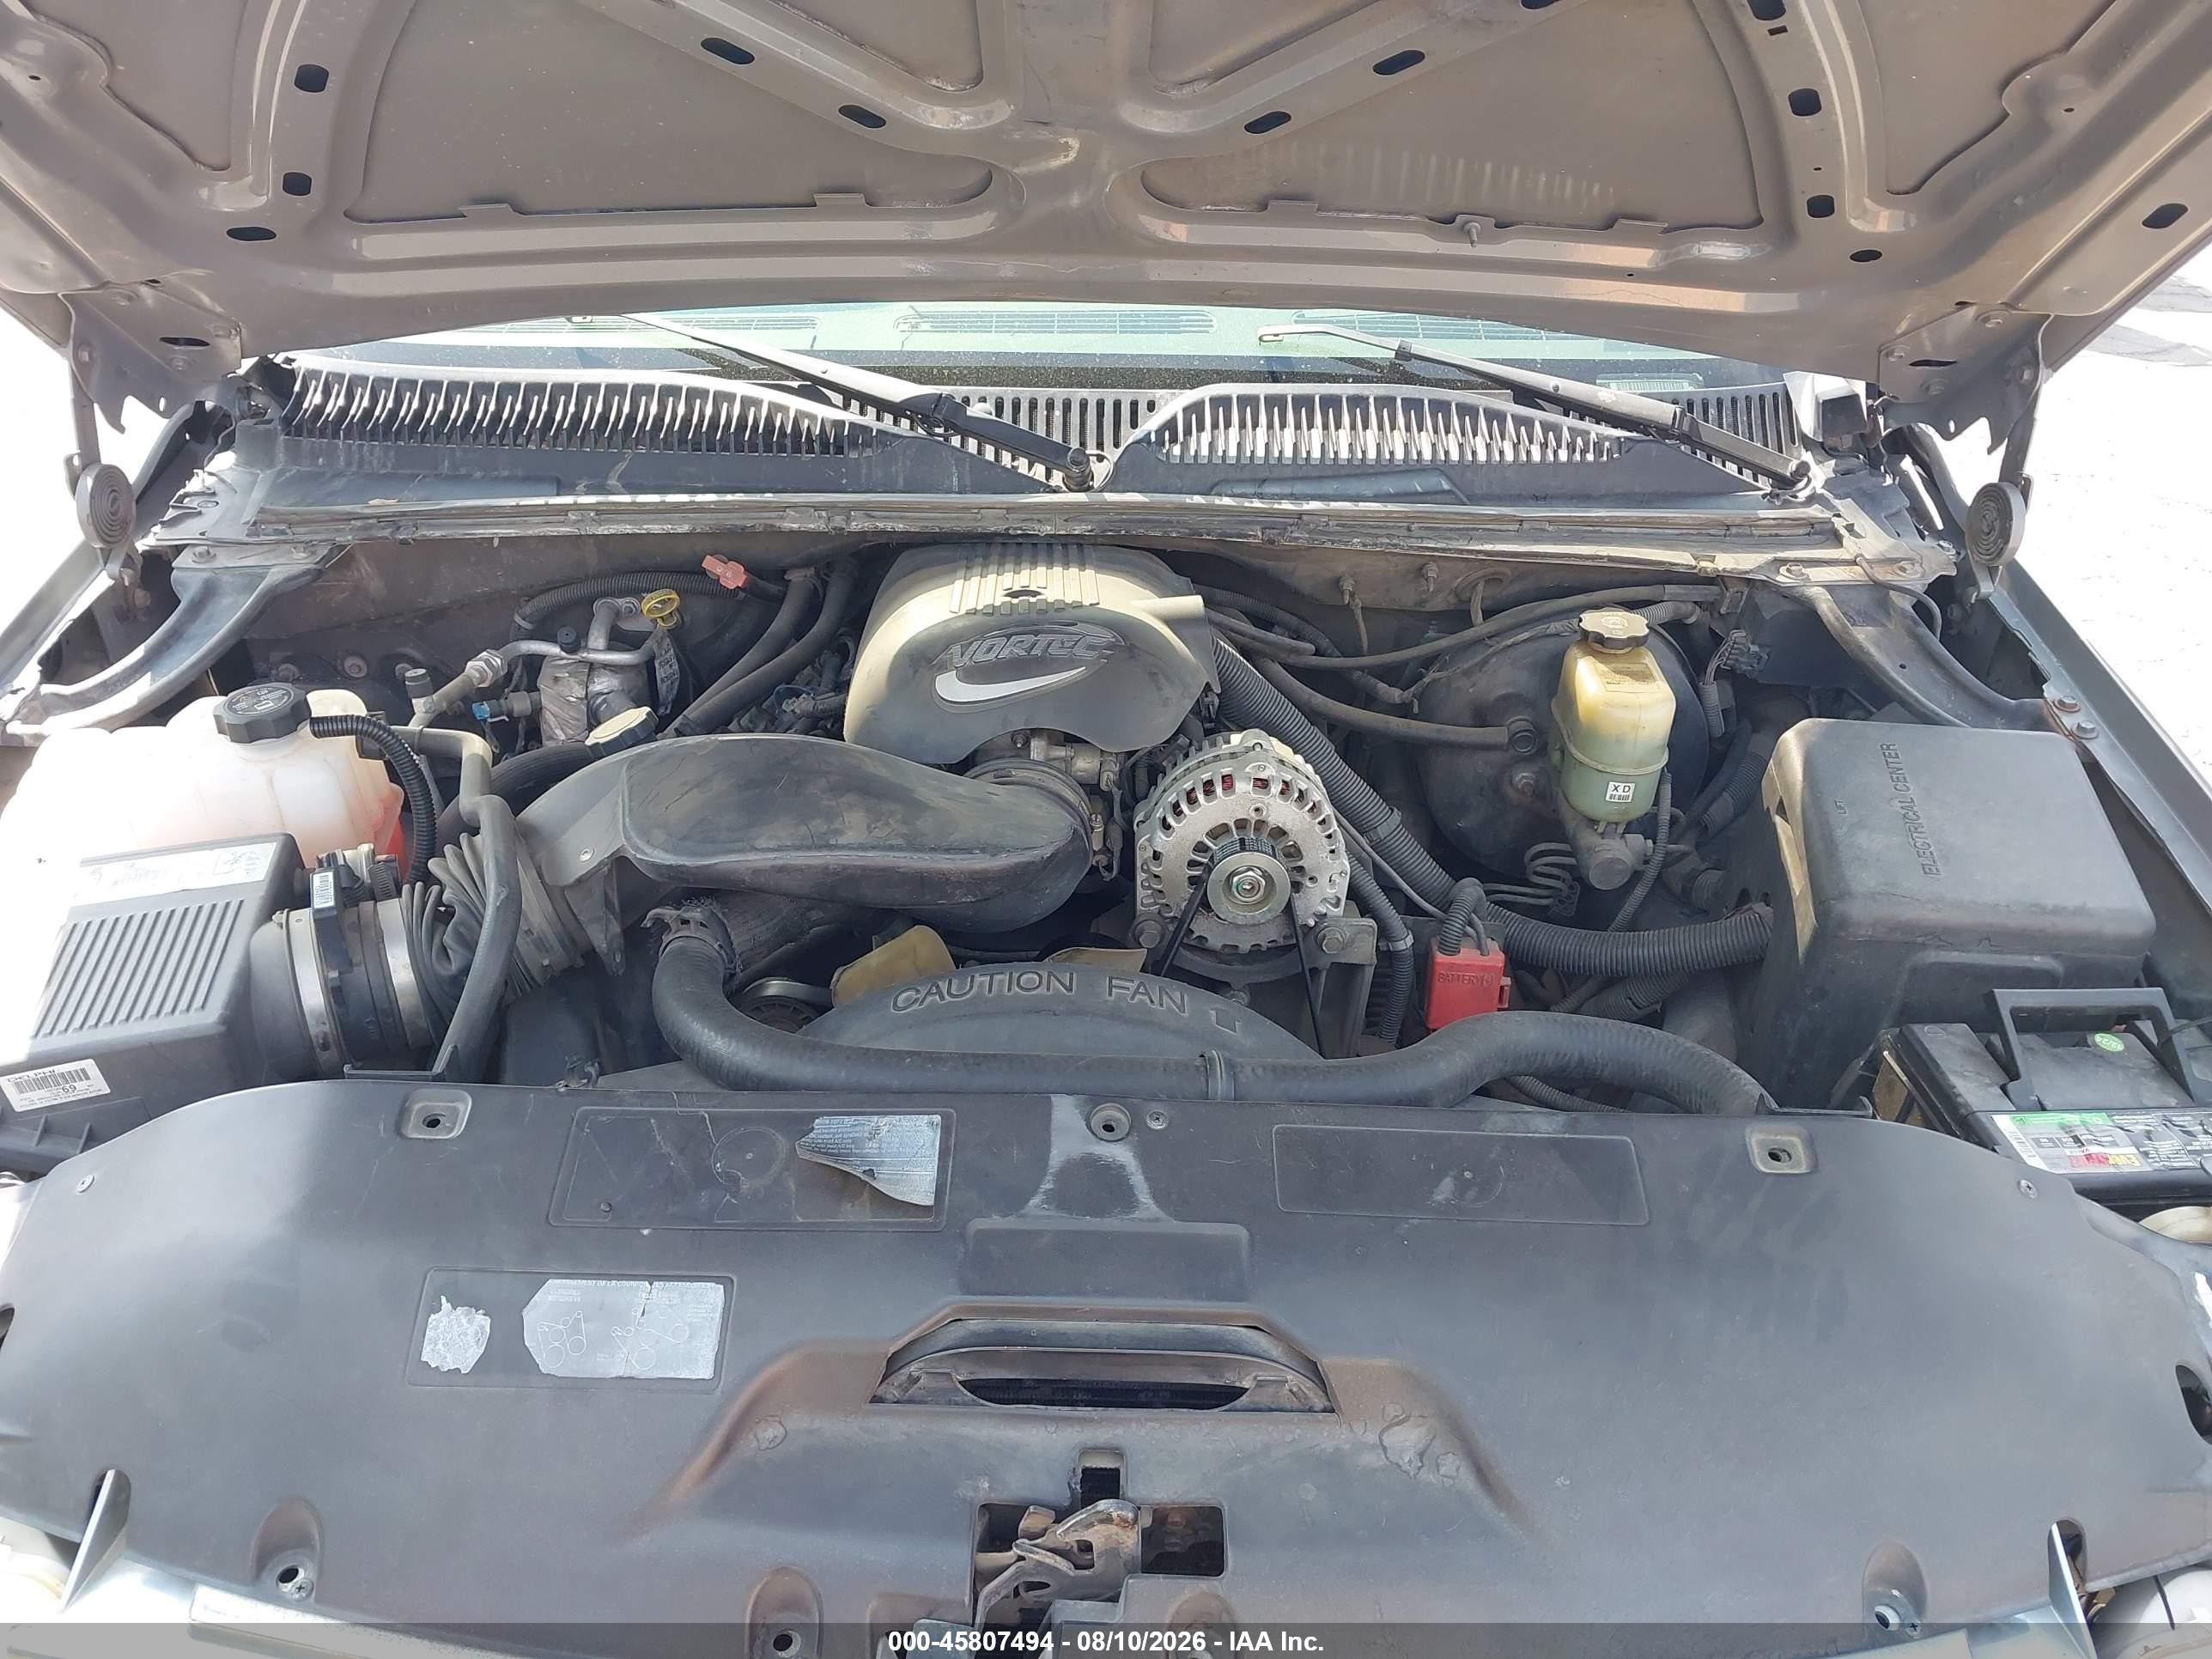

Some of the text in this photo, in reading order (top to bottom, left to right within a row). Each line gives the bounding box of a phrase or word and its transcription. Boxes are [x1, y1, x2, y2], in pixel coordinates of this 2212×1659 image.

[947, 634, 1114, 669] VORTEC
[1880, 743, 1942, 876] ELECTRICAL CENTER
[891, 970, 1188, 1016] CAUTION FAN
[7, 1069, 56, 1082] DELPHI
[62, 1084, 76, 1093] 69
